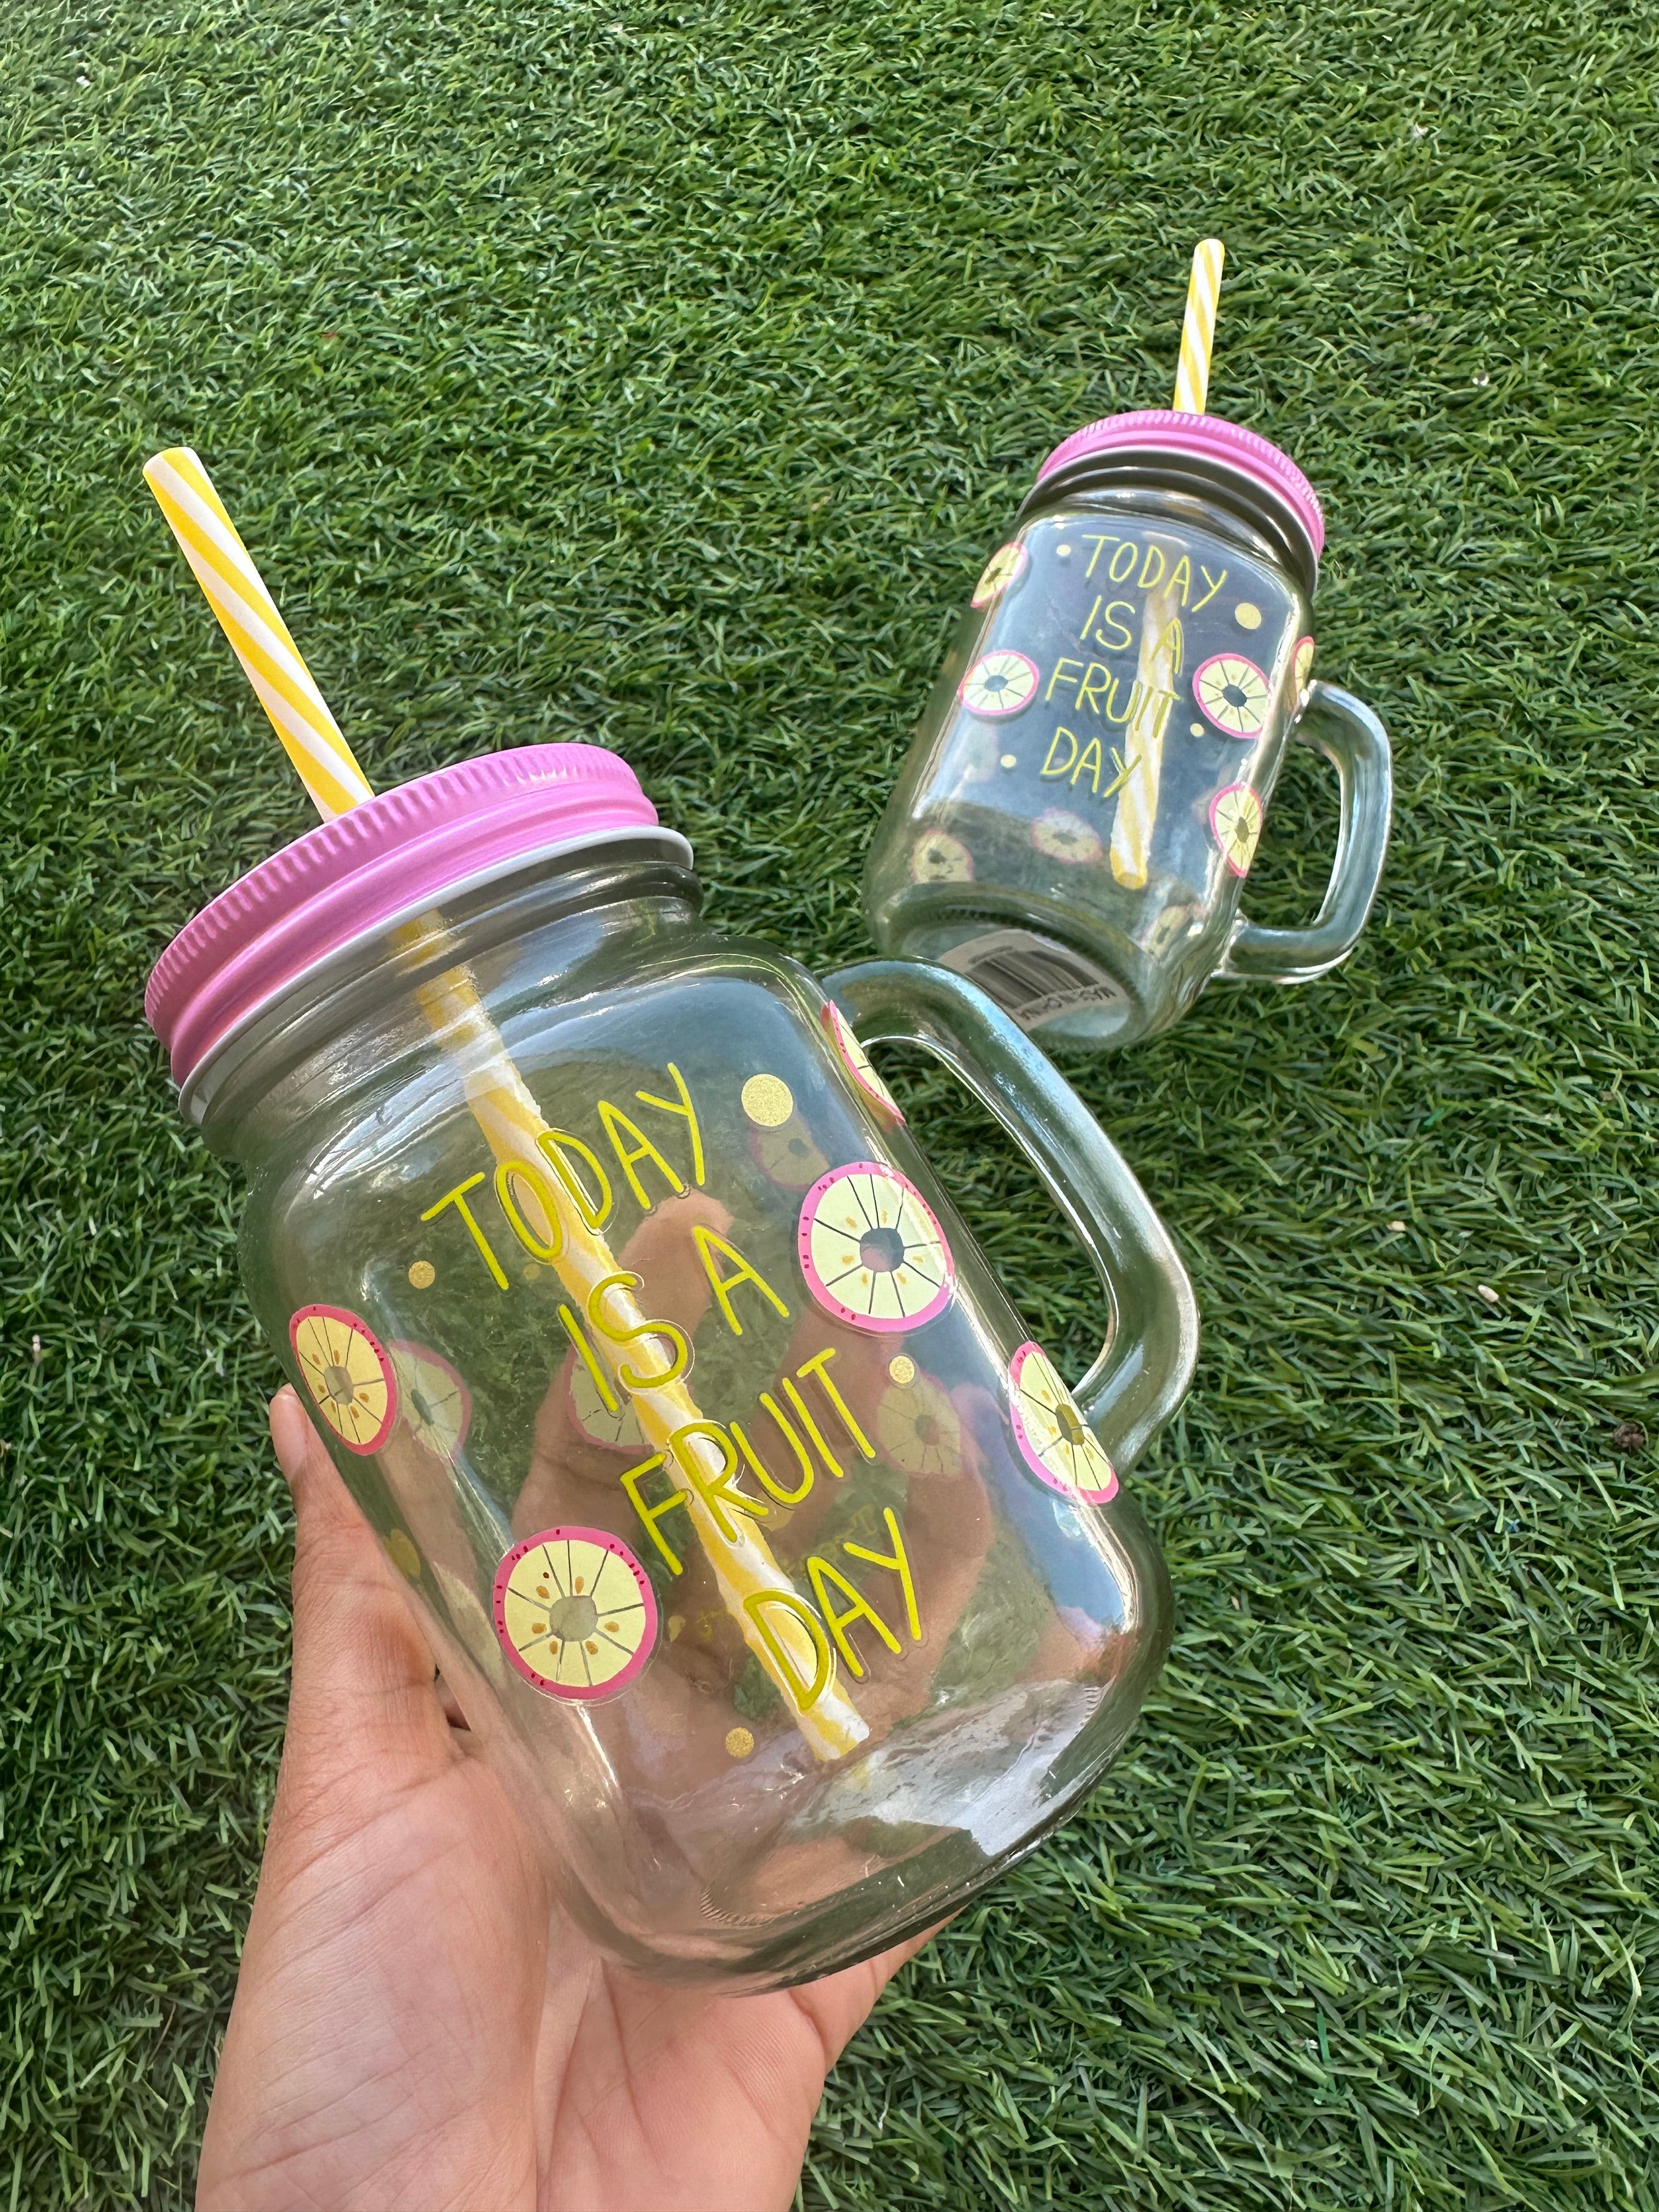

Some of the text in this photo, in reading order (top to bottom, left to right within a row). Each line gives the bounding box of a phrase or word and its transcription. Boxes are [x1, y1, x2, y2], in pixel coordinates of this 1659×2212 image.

[1080, 595, 1181, 674] IS A
[1082, 534, 1227, 612] TODAY
[1041, 727, 1141, 798] DAY
[1045, 657, 1180, 738] FRUIT
[420, 1063, 707, 1290] TODAY
[558, 1225, 791, 1413] IS A
[619, 1347, 876, 1575] FRUIT
[743, 1506, 922, 1710] DAY
